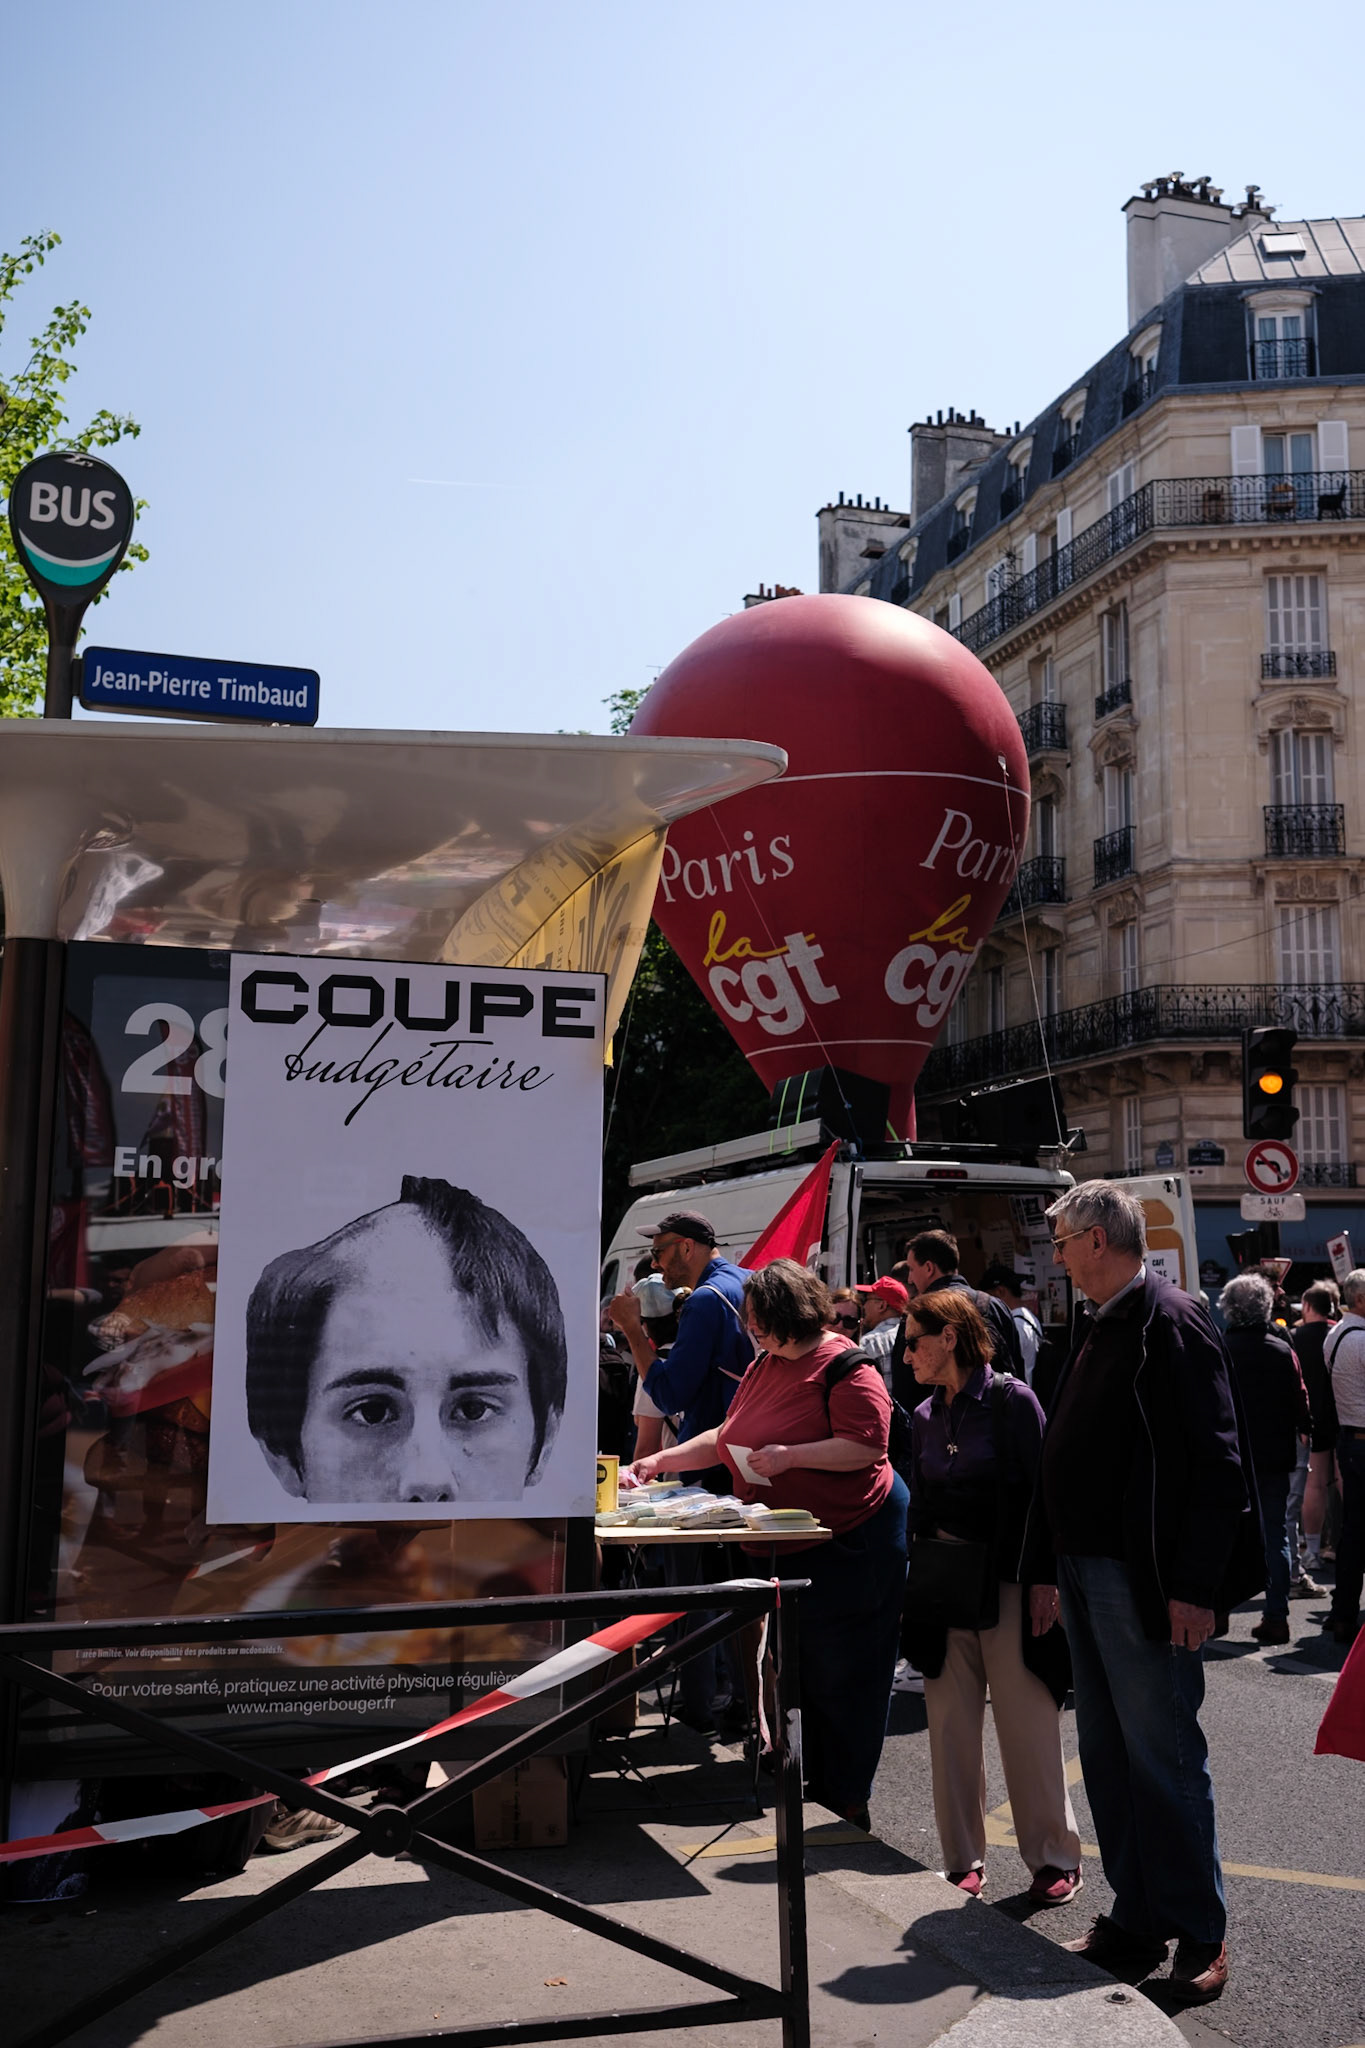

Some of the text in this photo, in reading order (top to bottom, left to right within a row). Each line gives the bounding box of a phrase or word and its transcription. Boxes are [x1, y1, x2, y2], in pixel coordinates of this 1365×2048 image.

[28, 481, 117, 531] BUS
[92, 664, 309, 709] Jean-Pierre Timbaud
[659, 831, 795, 903] Paris
[919, 808, 1022, 885] Pari
[702, 910, 816, 968] la
[908, 894, 976, 953] la
[241, 971, 596, 1039] COUPE
[708, 931, 840, 1036] cgt
[285, 1022, 554, 1125] budgétaire
[113, 1146, 163, 1179] En
[1260, 1197, 1286, 1205] SAUF
[125, 1648, 139, 1657] Voir
[140, 1646, 183, 1658] disponibilité
[184, 1647, 196, 1656] des
[197, 1646, 226, 1657] produits
[227, 1647, 238, 1655] sur
[92, 1682, 130, 1697] Pour
[132, 1681, 173, 1696] votre
[175, 1678, 222, 1697] santé,
[224, 1677, 297, 1698] pratiquez
[299, 1679, 328, 1692] une
[330, 1673, 385, 1691] activité
[387, 1672, 455, 1693] physique
[226, 1696, 397, 1716] www.mangerbouger.fr
